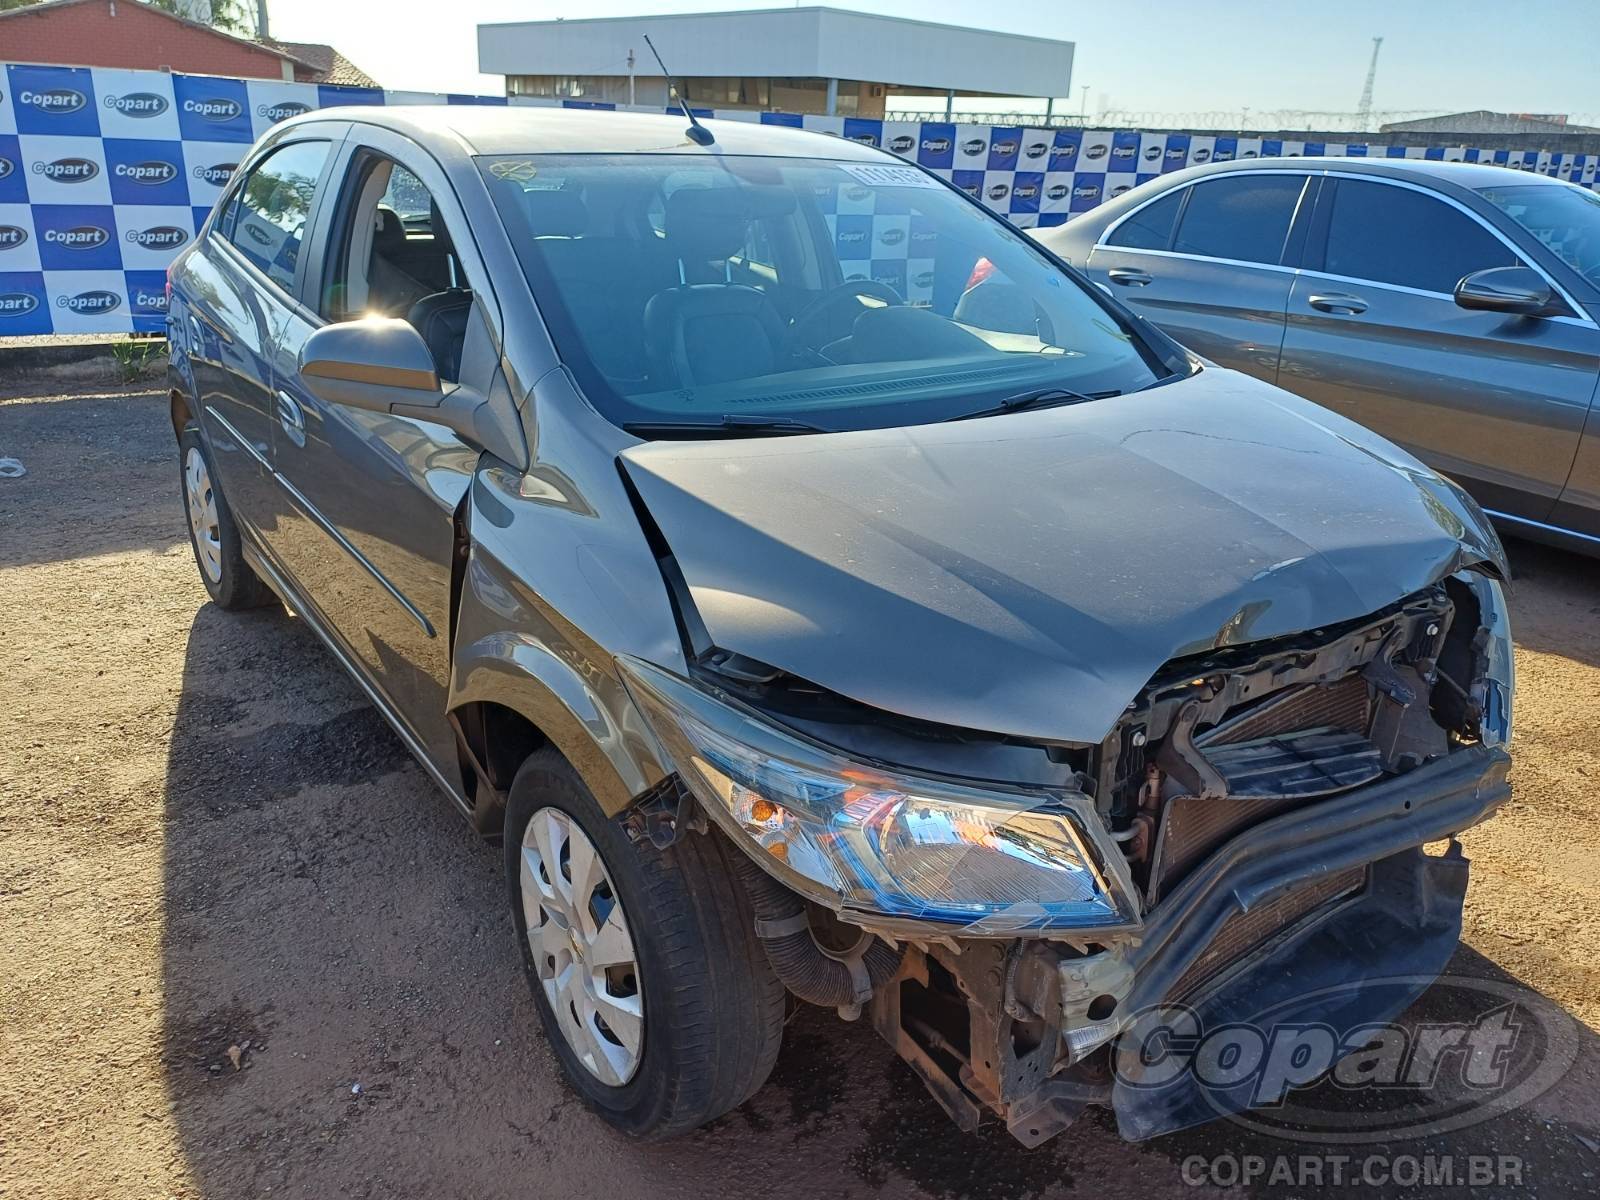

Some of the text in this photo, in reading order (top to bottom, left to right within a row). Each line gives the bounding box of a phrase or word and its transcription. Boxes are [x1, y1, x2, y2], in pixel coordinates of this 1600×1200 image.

[20, 91, 78, 107] Copart
[104, 95, 158, 111] Copart
[184, 100, 235, 116] Copart
[32, 161, 89, 177] Copart
[115, 164, 169, 179] Copart
[44, 229, 101, 245] Copart
[126, 229, 178, 246] Copart
[56, 294, 112, 311] Copart
